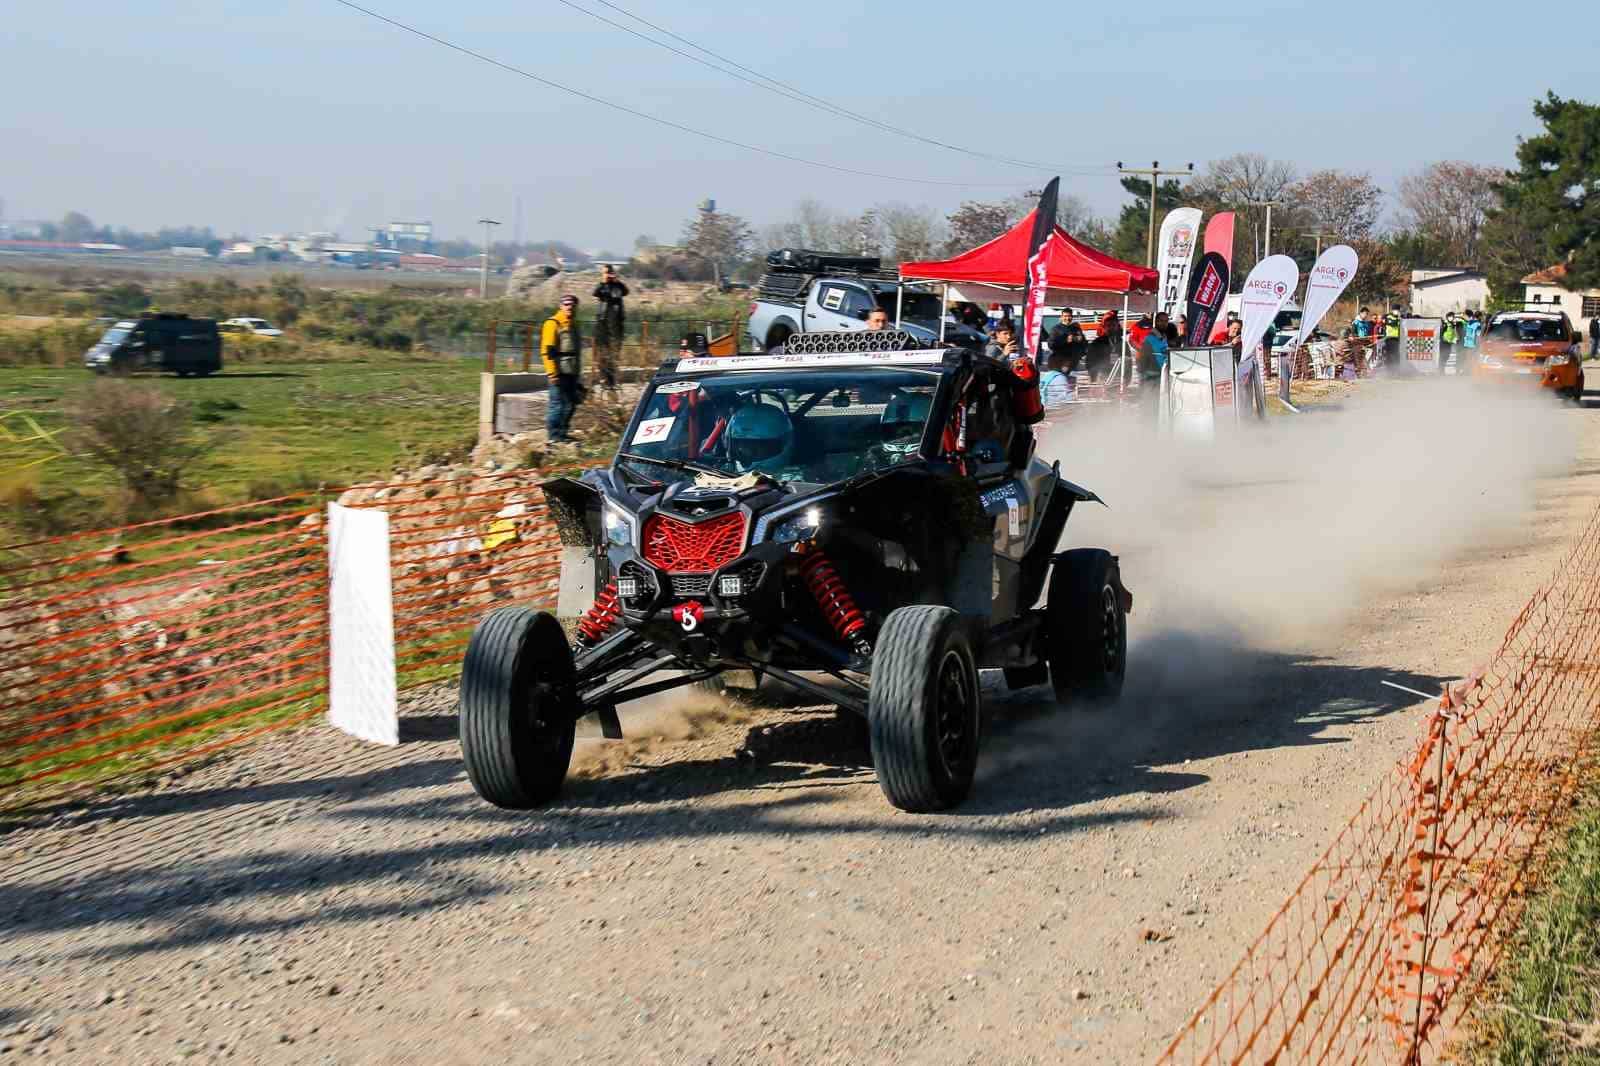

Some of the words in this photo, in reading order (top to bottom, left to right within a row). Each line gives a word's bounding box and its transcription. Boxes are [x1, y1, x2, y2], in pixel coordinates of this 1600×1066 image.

[1314, 266, 1336, 274] ARGE
[1200, 271, 1217, 303] WARN
[1247, 279, 1273, 290] ARGE
[641, 423, 667, 438] 57
